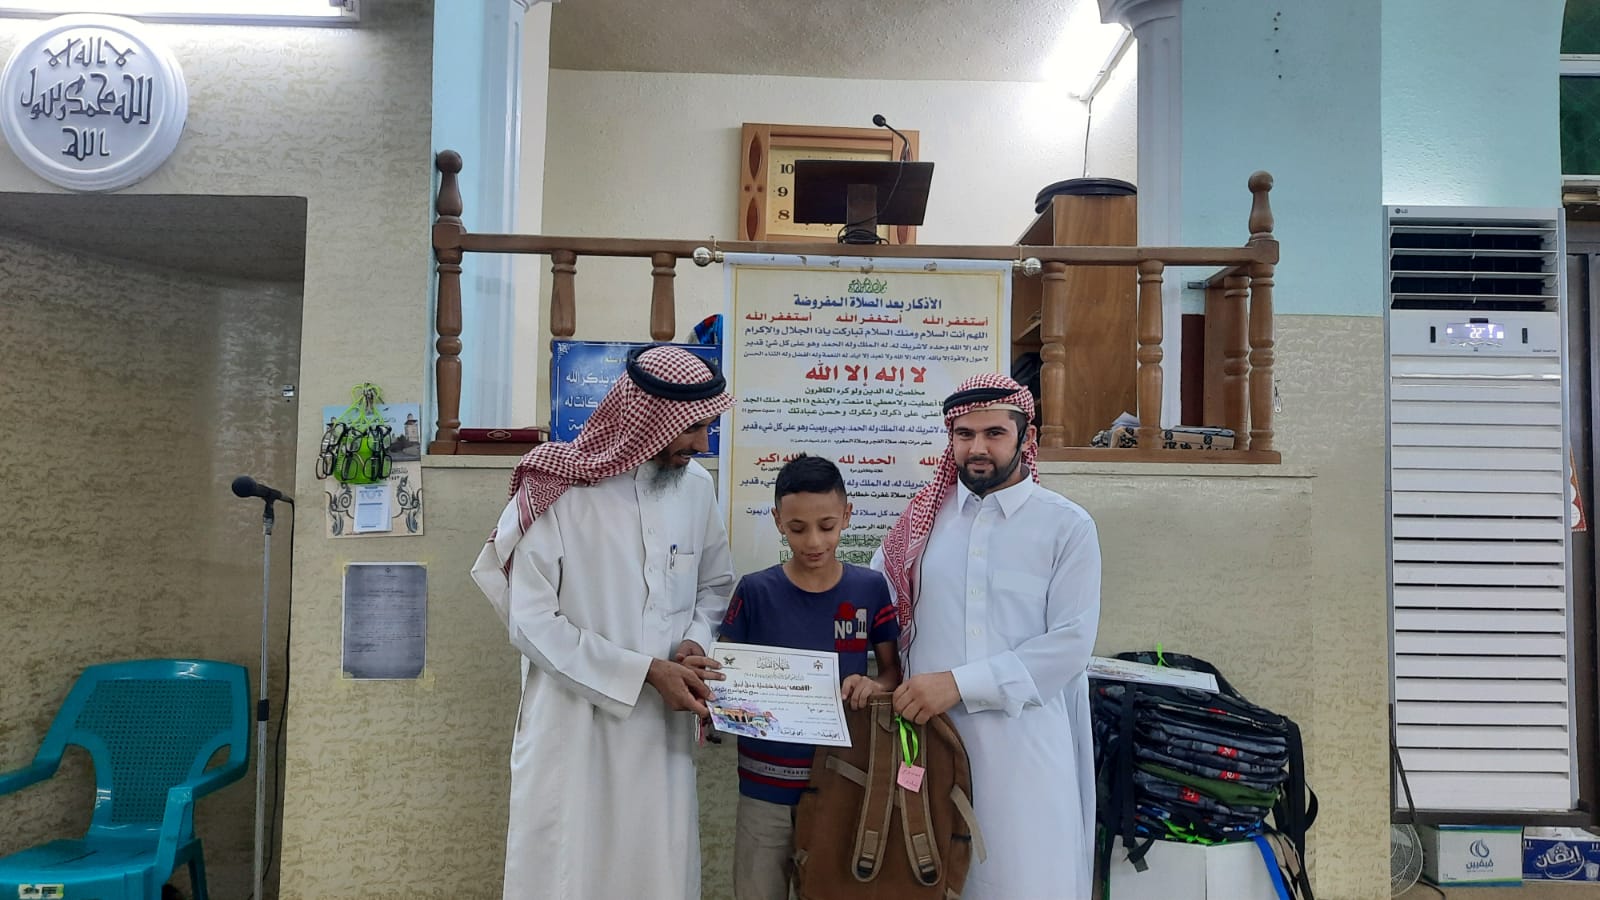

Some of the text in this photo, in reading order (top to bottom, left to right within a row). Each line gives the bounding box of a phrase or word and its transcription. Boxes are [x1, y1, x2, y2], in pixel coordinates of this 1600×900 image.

[62, 126, 110, 162] الله
[780, 163, 795, 175] 10
[777, 186, 789, 197] 9
[778, 209, 790, 221] 8
[793, 294, 848, 310] المفروضة
[849, 296, 883, 309] الصلاة
[886, 299, 904, 313] بعد
[745, 311, 767, 321] الله
[836, 312, 858, 323] الله
[923, 315, 944, 325] الله
[781, 326, 813, 336] الجلال
[832, 327, 863, 339] تباركت
[864, 327, 893, 339] السلام
[894, 328, 919, 340] ومنك
[920, 329, 949, 341] السلام
[966, 331, 988, 341] اللهم
[566, 369, 580, 383] الله
[805, 359, 837, 381] الله
[911, 366, 927, 383] لا
[804, 386, 835, 395] الكافرون
[863, 388, 884, 396] الدين
[878, 424, 897, 432] الملك
[838, 454, 895, 465] الحمد لله
[860, 479, 882, 487] الملك
